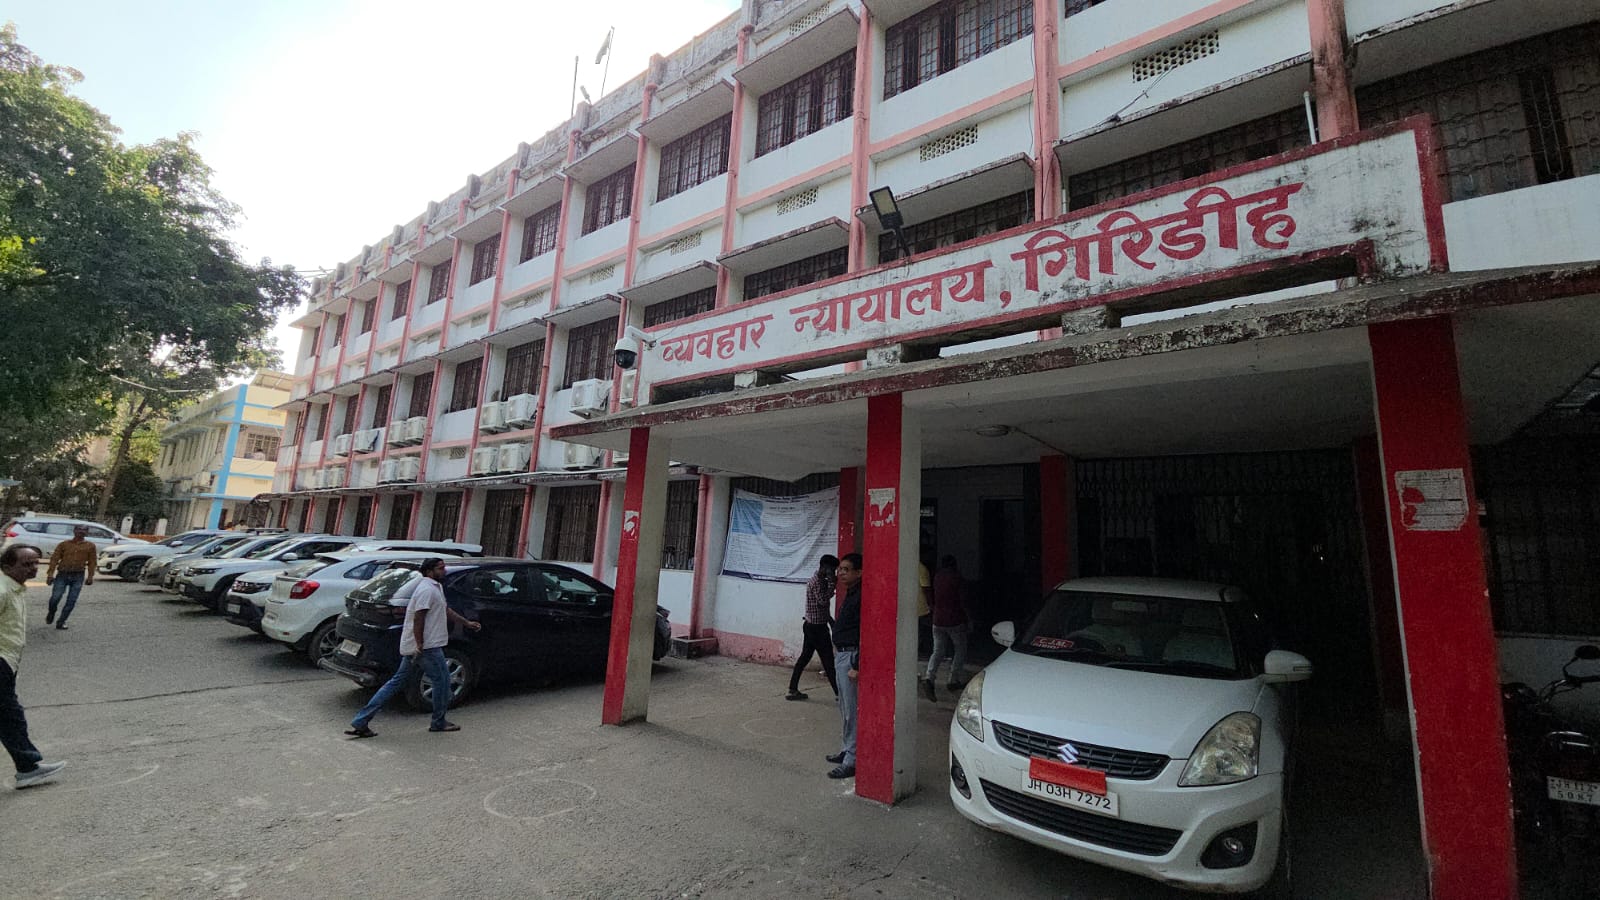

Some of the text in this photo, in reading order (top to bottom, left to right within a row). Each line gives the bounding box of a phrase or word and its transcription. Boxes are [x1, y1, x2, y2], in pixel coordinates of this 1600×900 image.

[661, 316, 773, 365] व्यवहार
[1012, 181, 1304, 293] गिरिडीह
[1027, 779, 1112, 810] JH 03H 7272
